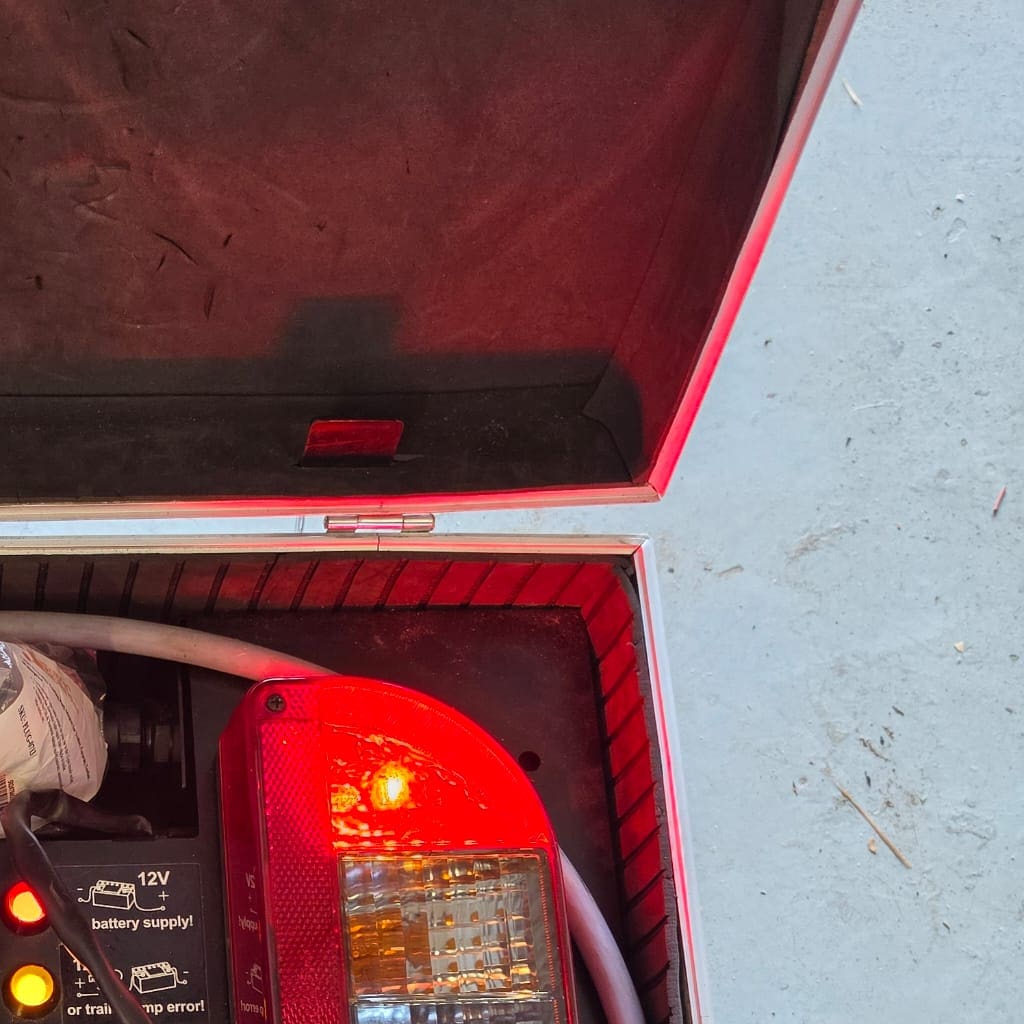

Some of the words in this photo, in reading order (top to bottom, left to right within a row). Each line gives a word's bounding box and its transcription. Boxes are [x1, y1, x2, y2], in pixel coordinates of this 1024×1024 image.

[137, 870, 170, 886] 12V
[91, 918, 140, 931] battery
[143, 915, 194, 931] supply!
[67, 1006, 82, 1016] or
[166, 1000, 205, 1013] error!
